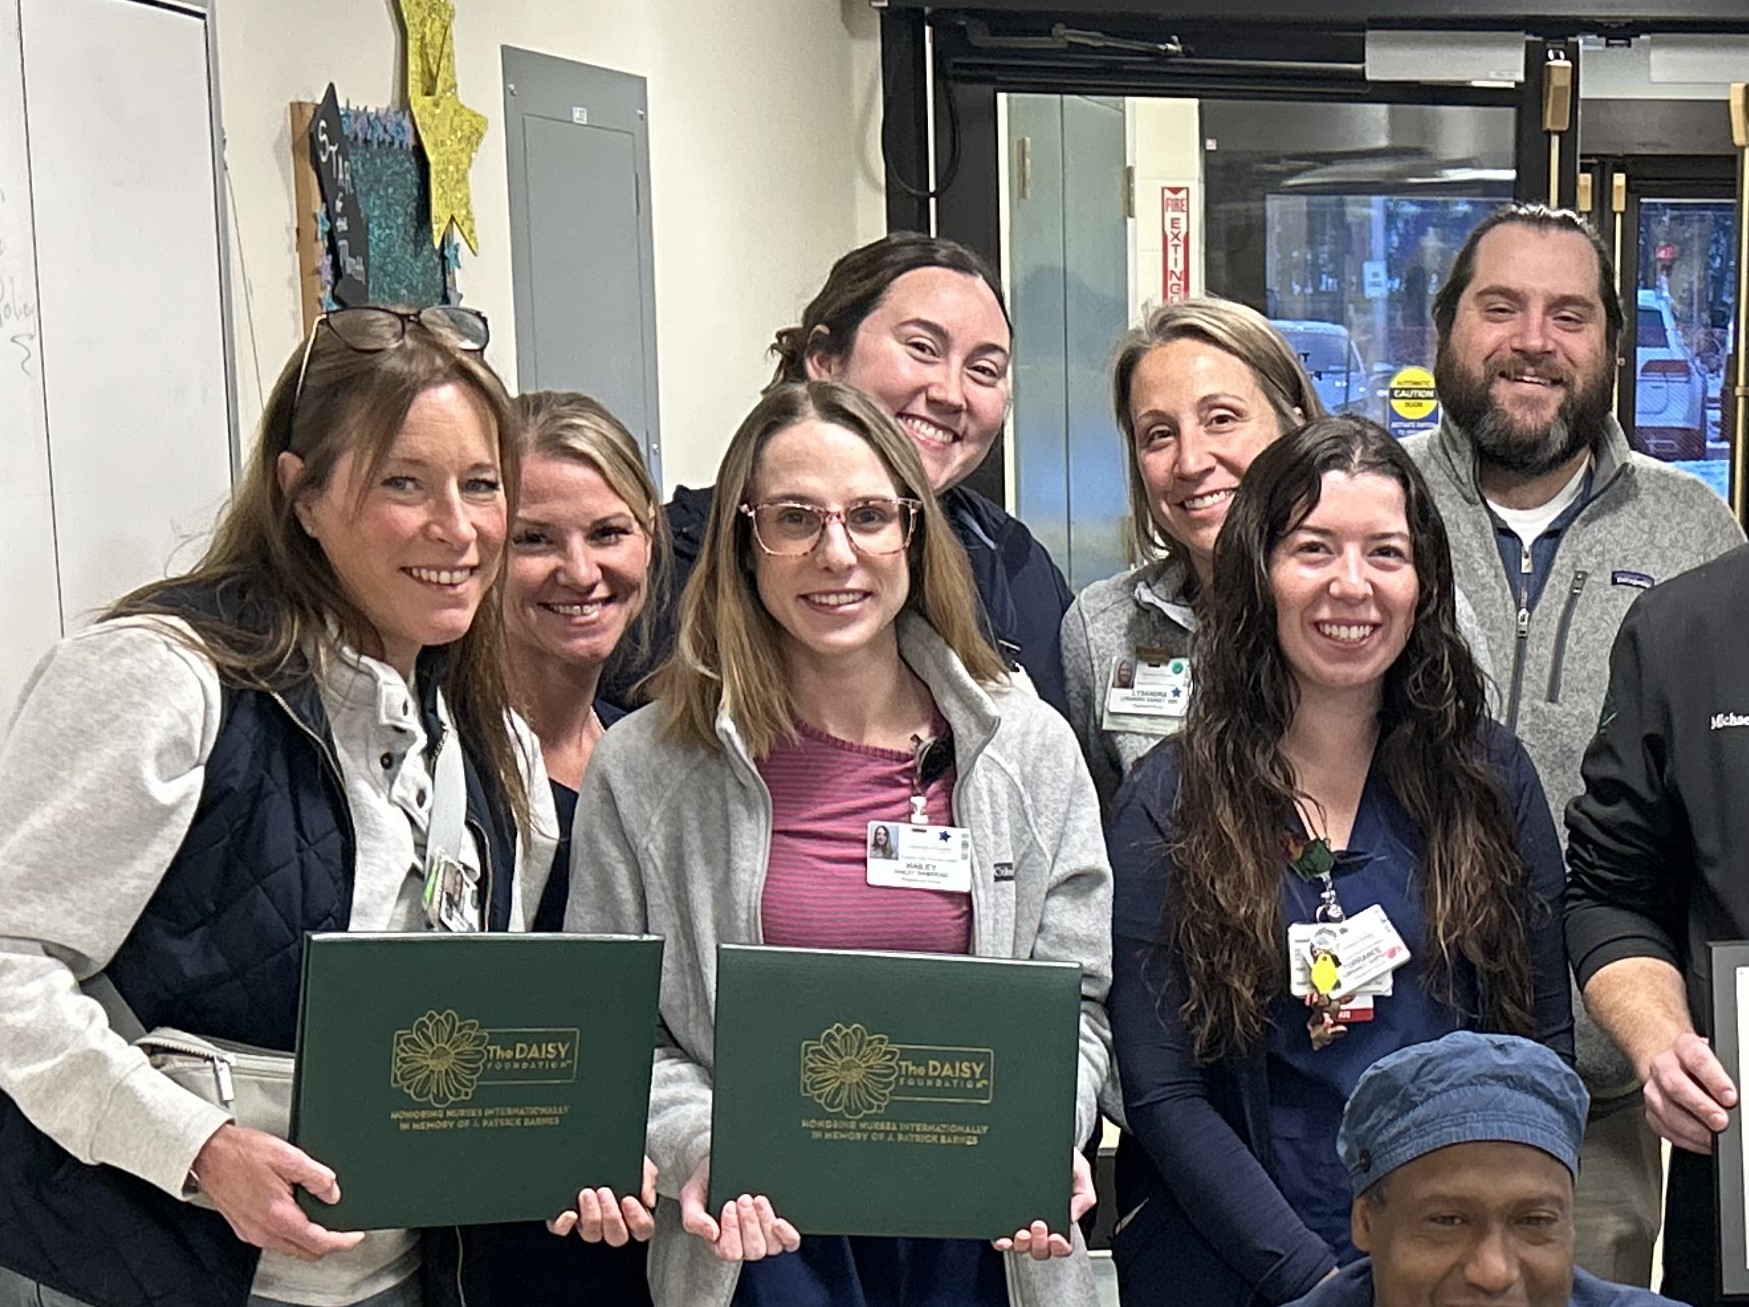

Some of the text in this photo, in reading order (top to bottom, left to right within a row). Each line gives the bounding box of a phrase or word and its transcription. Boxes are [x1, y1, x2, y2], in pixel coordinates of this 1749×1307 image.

[1165, 198, 1186, 212] FIRE
[1394, 389, 1434, 398] CAUTION
[487, 1042, 571, 1060] The DAISY
[900, 1060, 985, 1078] The DAISY
[391, 1105, 570, 1120] HONORING NURSES INTERNATIONALLY
[400, 1121, 411, 1131] IN
[412, 1120, 454, 1130] MEMORY
[456, 1119, 470, 1129] OF
[482, 1118, 521, 1128] PATRICK
[523, 1117, 560, 1127] BARNES
[801, 1118, 989, 1135] HONORING NURSES INTERNATIONALLY
[811, 1131, 823, 1140] IN
[824, 1131, 869, 1142] MEMORY
[871, 1133, 885, 1142] OF
[897, 1134, 938, 1144] PATRICK
[940, 1135, 979, 1145] BARNES
